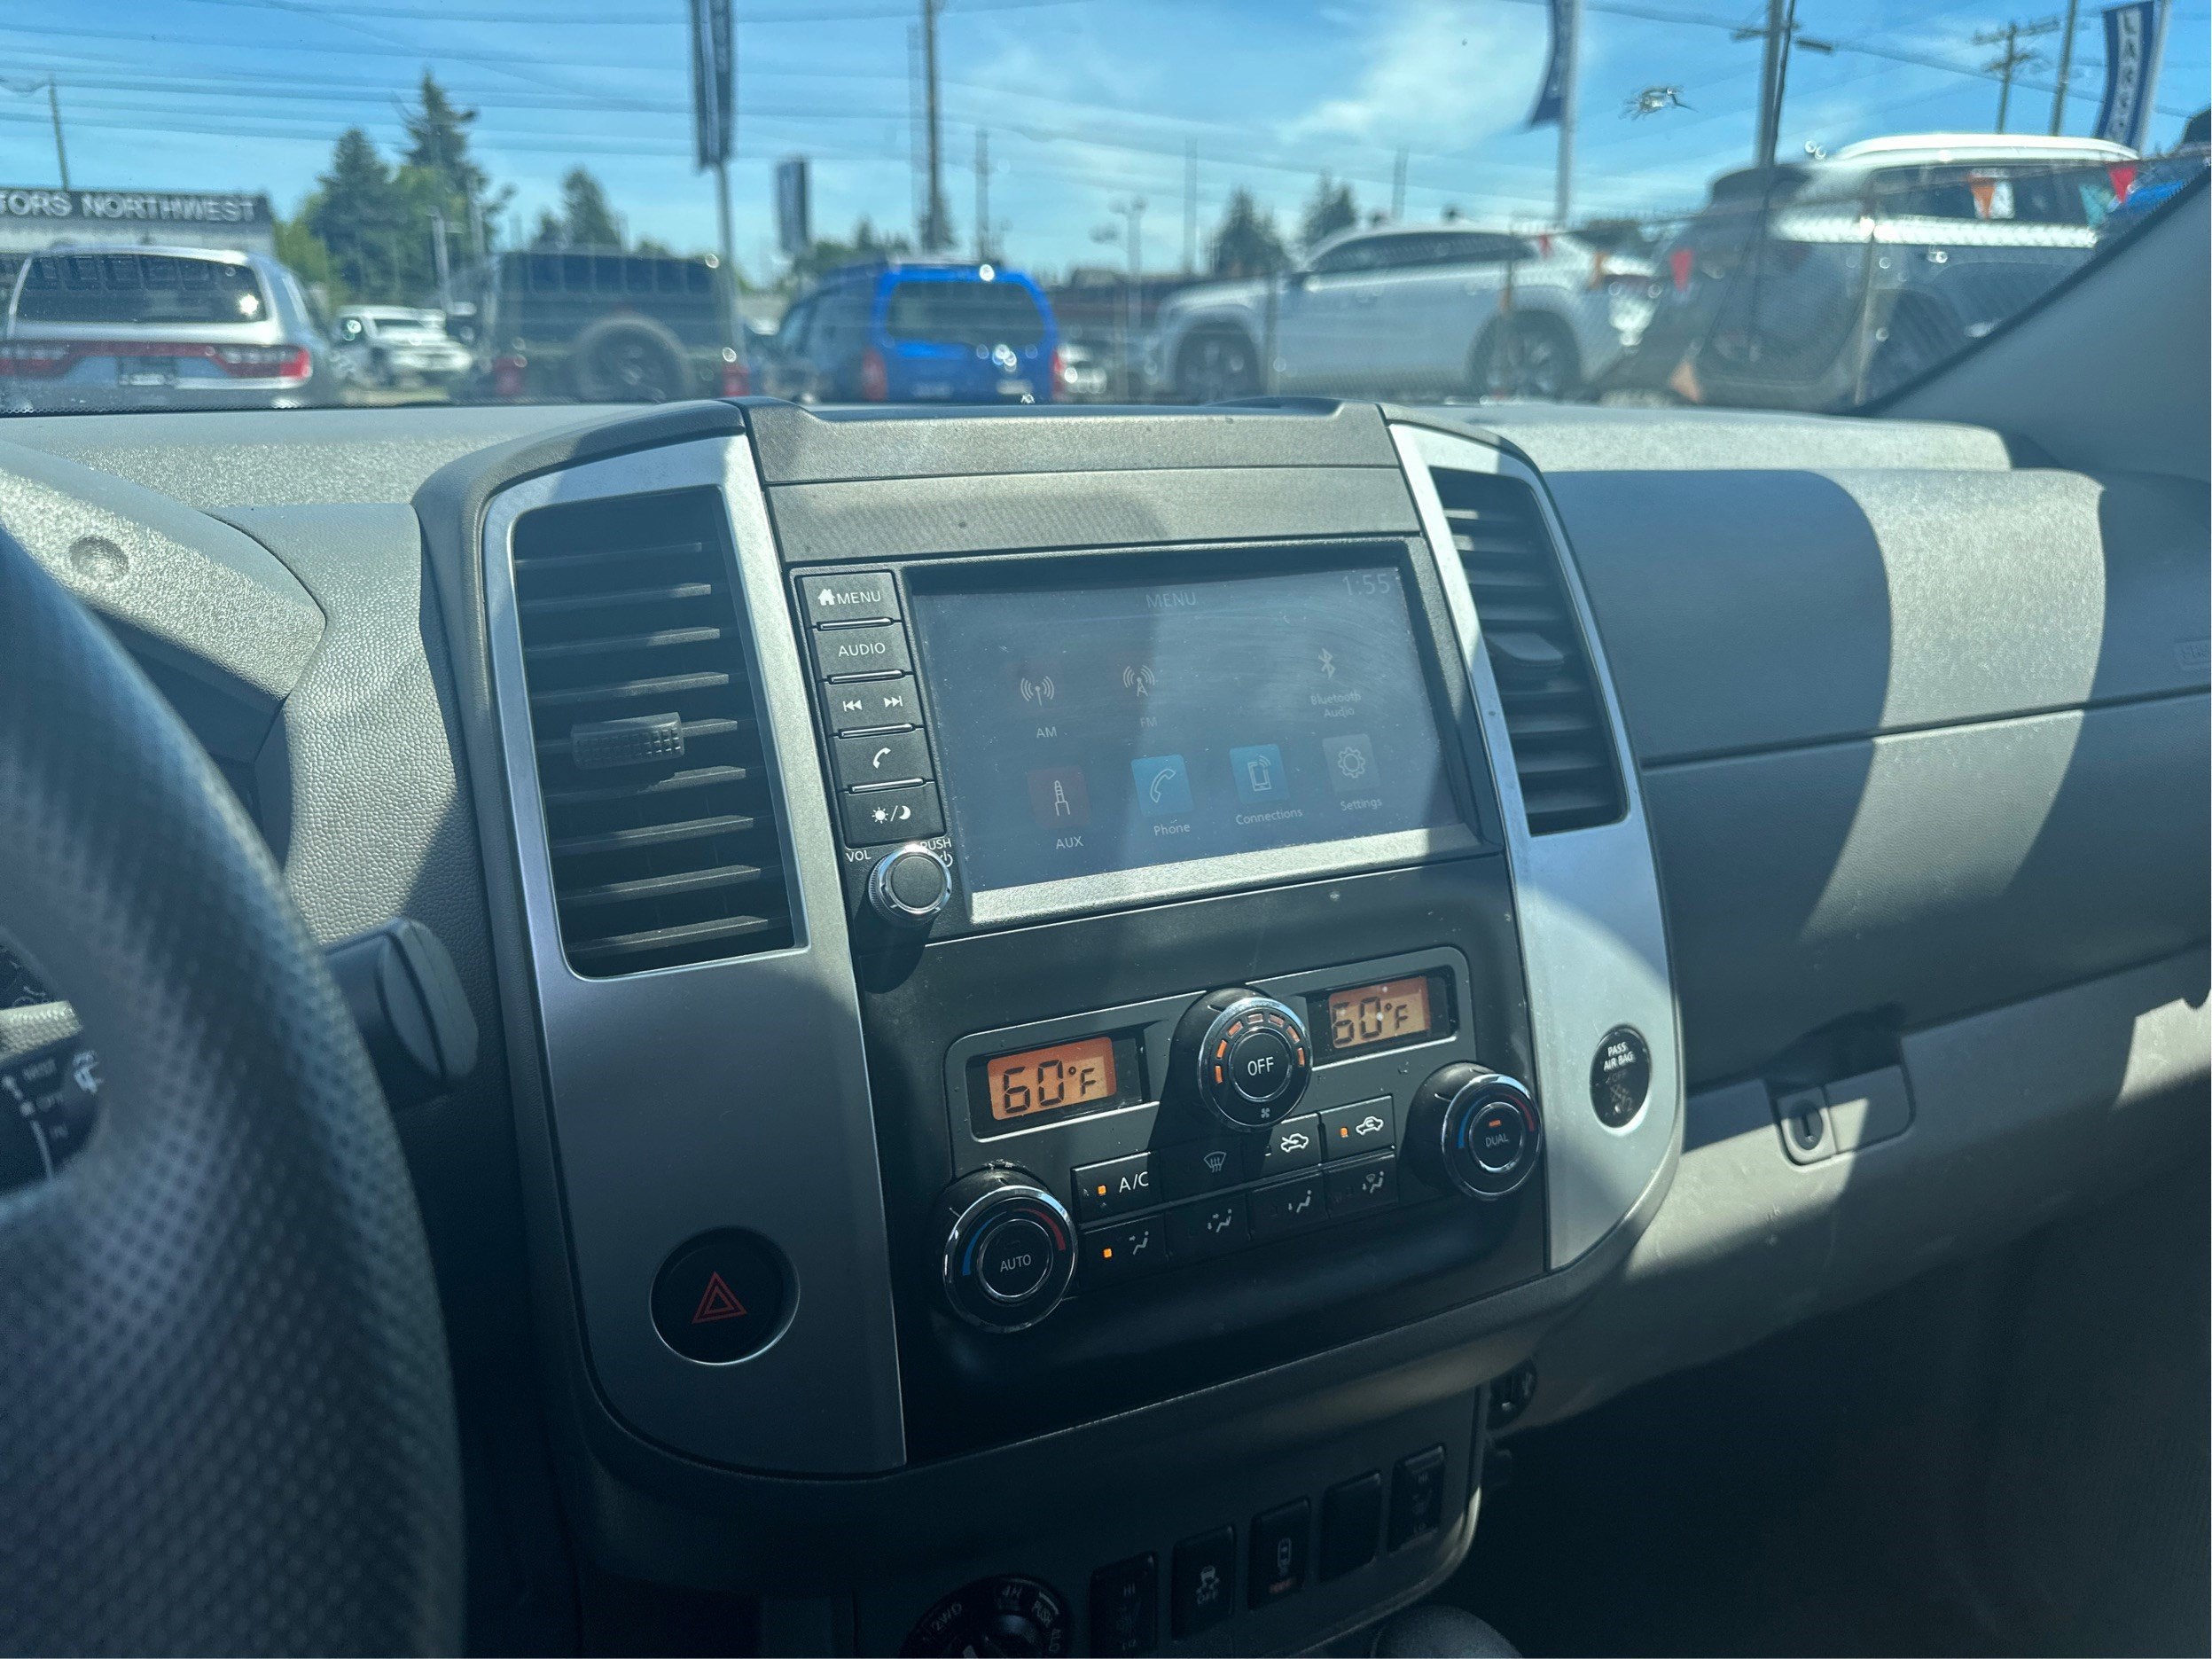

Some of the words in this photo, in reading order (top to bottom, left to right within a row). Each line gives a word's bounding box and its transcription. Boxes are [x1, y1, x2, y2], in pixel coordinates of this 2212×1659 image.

[81, 192, 255, 222] NORTHWEST
[1342, 573, 1391, 596] 1:55
[836, 591, 881, 605] MENU
[1145, 591, 1197, 609] MENU
[838, 642, 886, 657] AUDIO
[1310, 689, 1362, 706] Bluetooth
[1323, 706, 1355, 719] Audio
[1036, 725, 1058, 740] AM
[1340, 796, 1383, 812] Settings
[1235, 807, 1303, 826] Connections
[1153, 821, 1192, 837] Phone
[1055, 835, 1084, 850] AUX
[846, 849, 872, 863] VOL
[1607, 1041, 1630, 1057] PASS
[1247, 1056, 1274, 1076] OFF
[1603, 1057, 1619, 1072] AIR
[1617, 1051, 1636, 1066] BAG
[1485, 1134, 1510, 1148] DUAL
[1118, 1171, 1150, 1193] A/C
[999, 1254, 1032, 1273] AUTO
